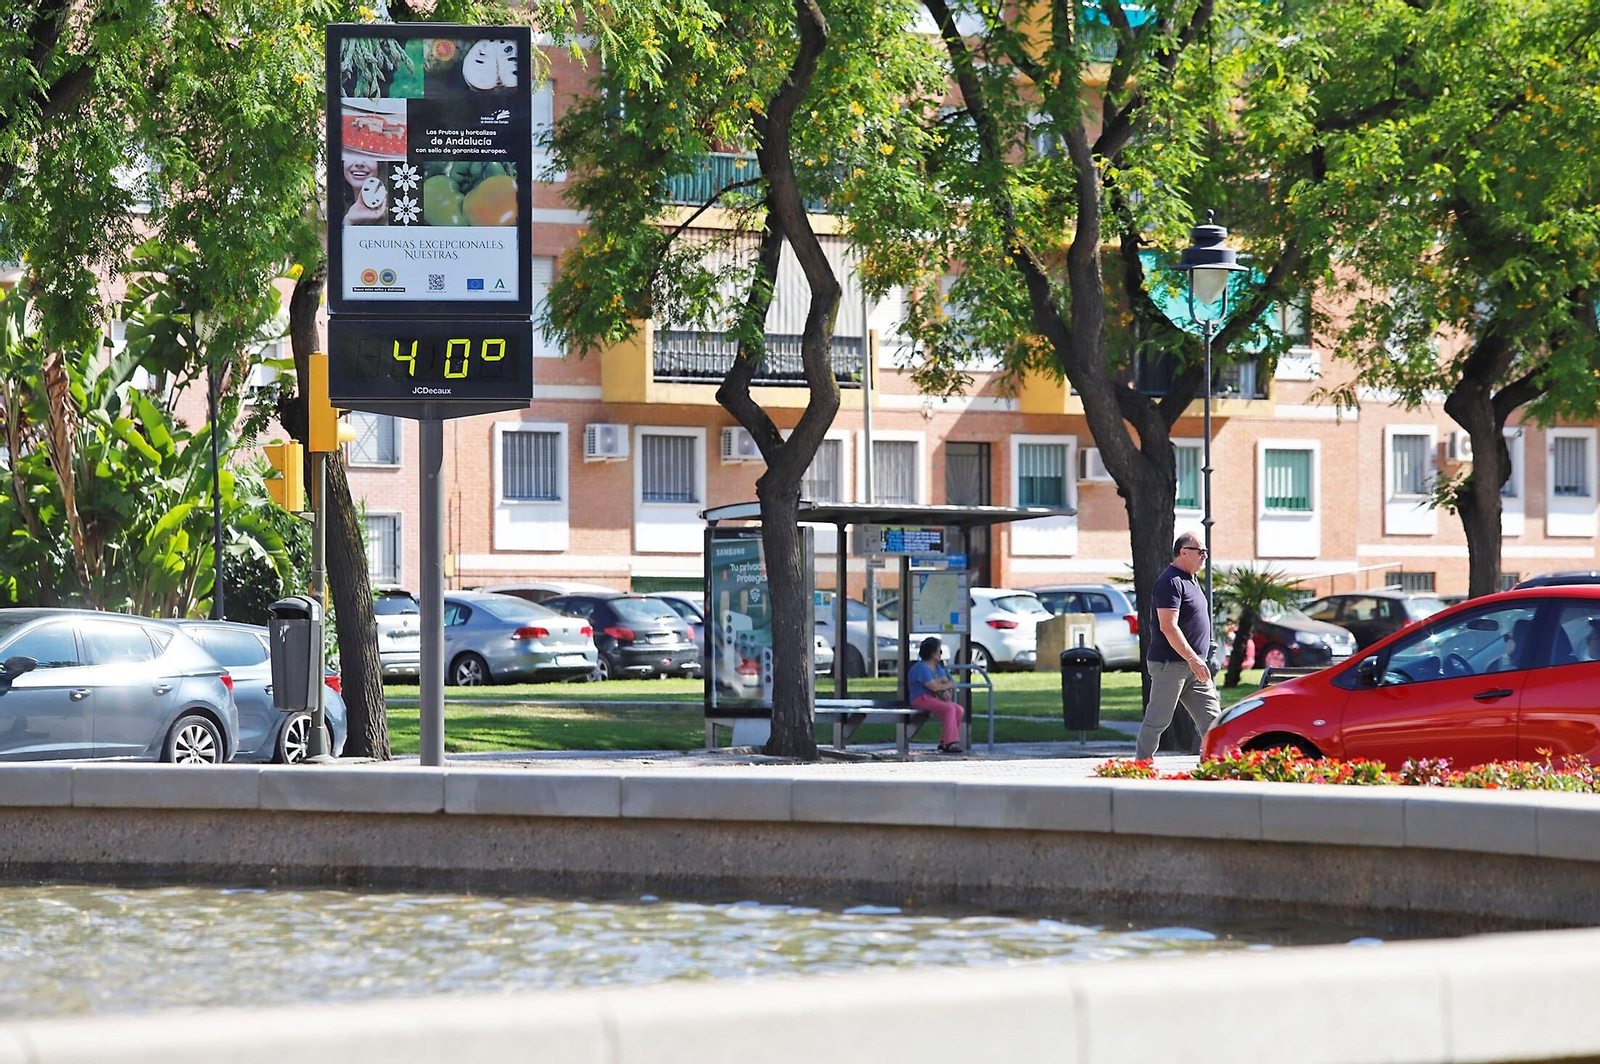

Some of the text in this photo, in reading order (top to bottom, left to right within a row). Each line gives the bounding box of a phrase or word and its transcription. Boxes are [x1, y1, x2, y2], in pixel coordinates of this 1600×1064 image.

[430, 136, 492, 146] de Andalucía
[452, 147, 480, 155] garantía
[419, 239, 505, 250] EXCEPCIONALES.
[412, 386, 452, 395] JCDecaux
[716, 547, 745, 556] SAMSUNG
[730, 563, 739, 572] Tu
